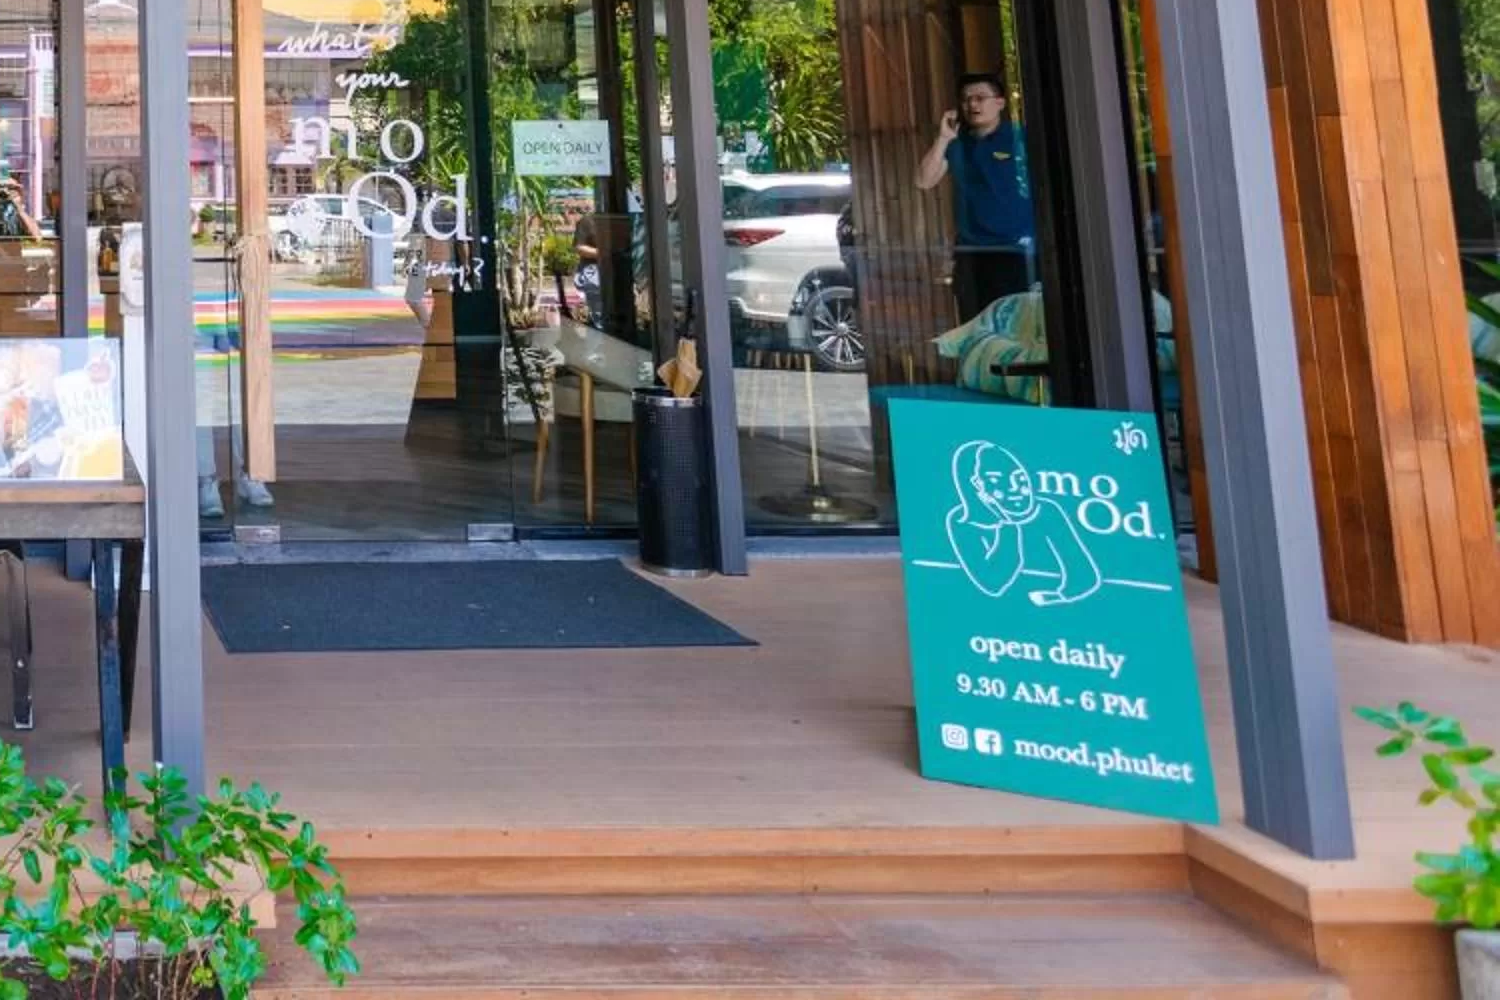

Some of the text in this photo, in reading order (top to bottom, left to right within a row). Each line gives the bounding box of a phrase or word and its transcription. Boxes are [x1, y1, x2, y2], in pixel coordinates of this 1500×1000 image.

[335, 70, 410, 115] your
[522, 141, 604, 156] OPEN DAILY
[969, 635, 1125, 679] open daily
[956, 673, 1007, 699] 9.30
[1012, 681, 1062, 707] AM
[1079, 690, 1097, 712] 6
[1100, 692, 1149, 720] PM
[1013, 739, 1195, 784] mood.phuket
